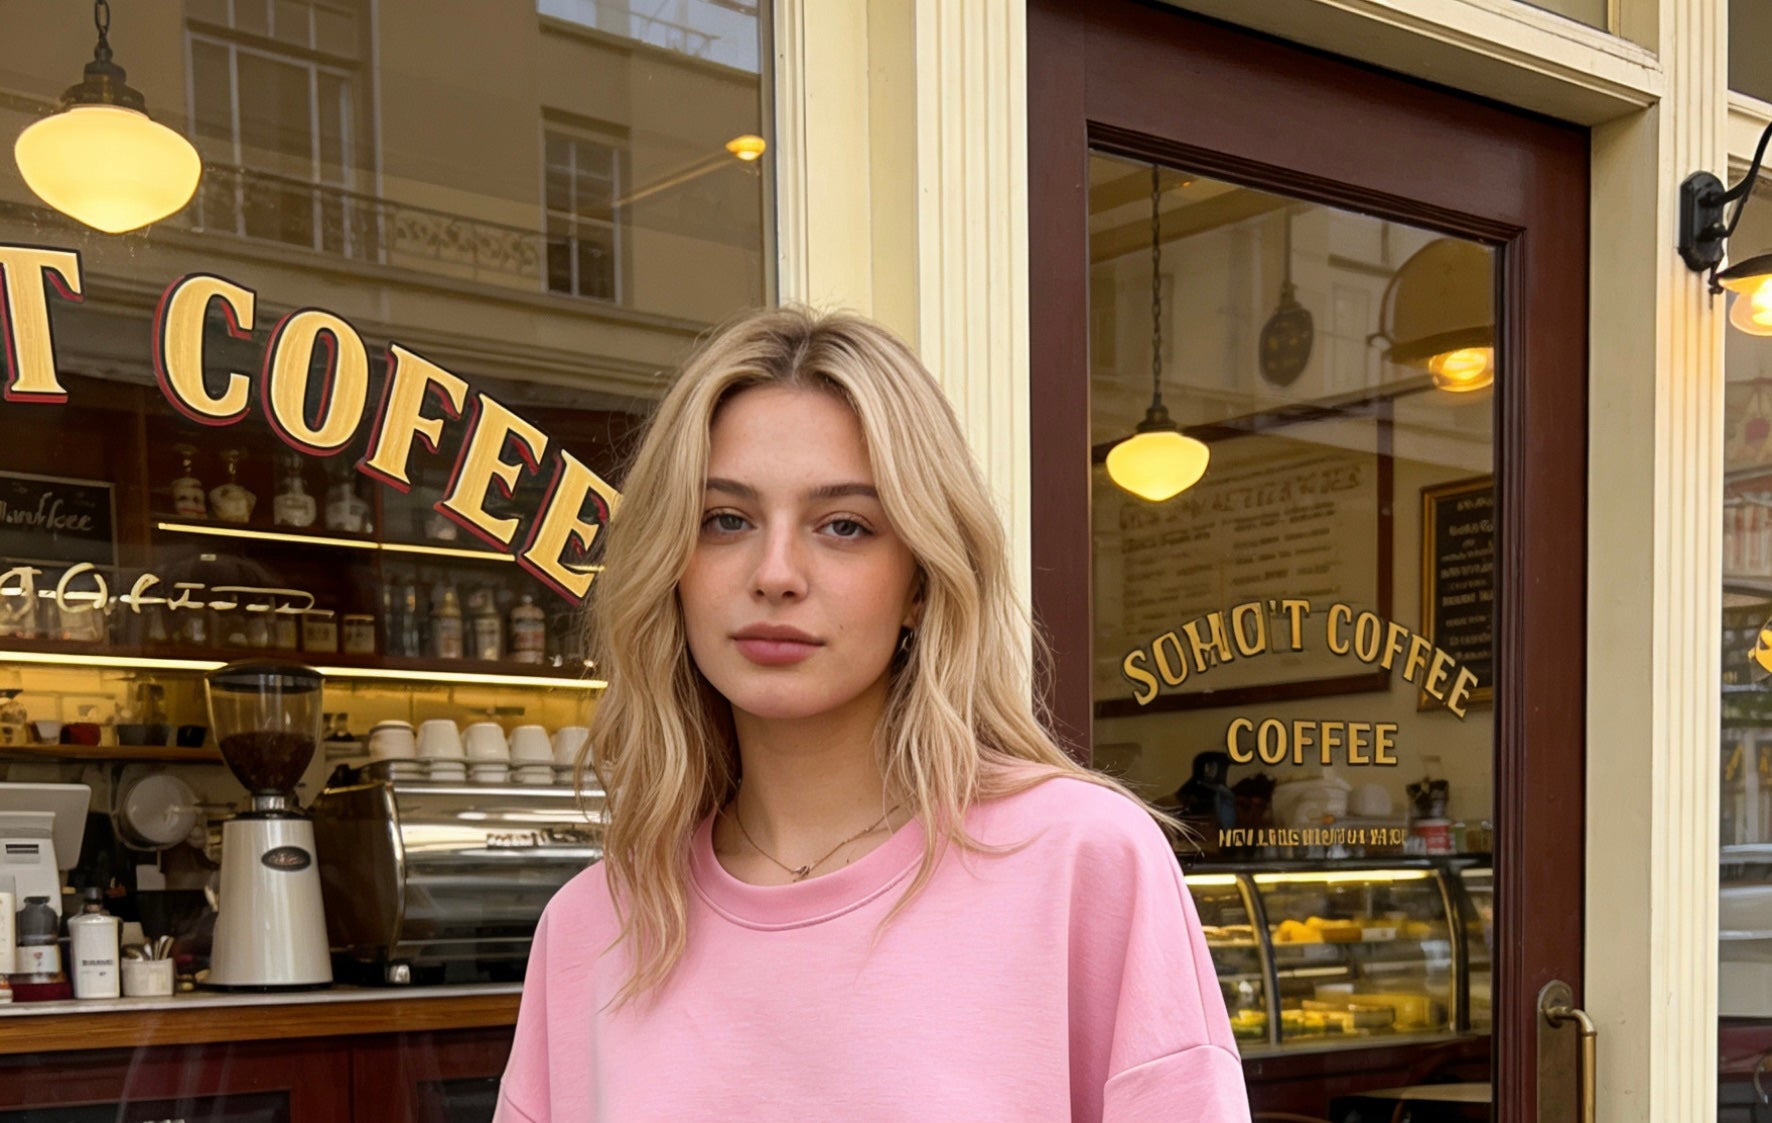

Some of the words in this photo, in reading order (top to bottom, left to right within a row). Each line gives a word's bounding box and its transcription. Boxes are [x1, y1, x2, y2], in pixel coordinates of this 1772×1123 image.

[154, 272, 624, 605] COFEE
[1325, 602, 1480, 720] COFFEE
[1225, 716, 1399, 766] COFFEE
